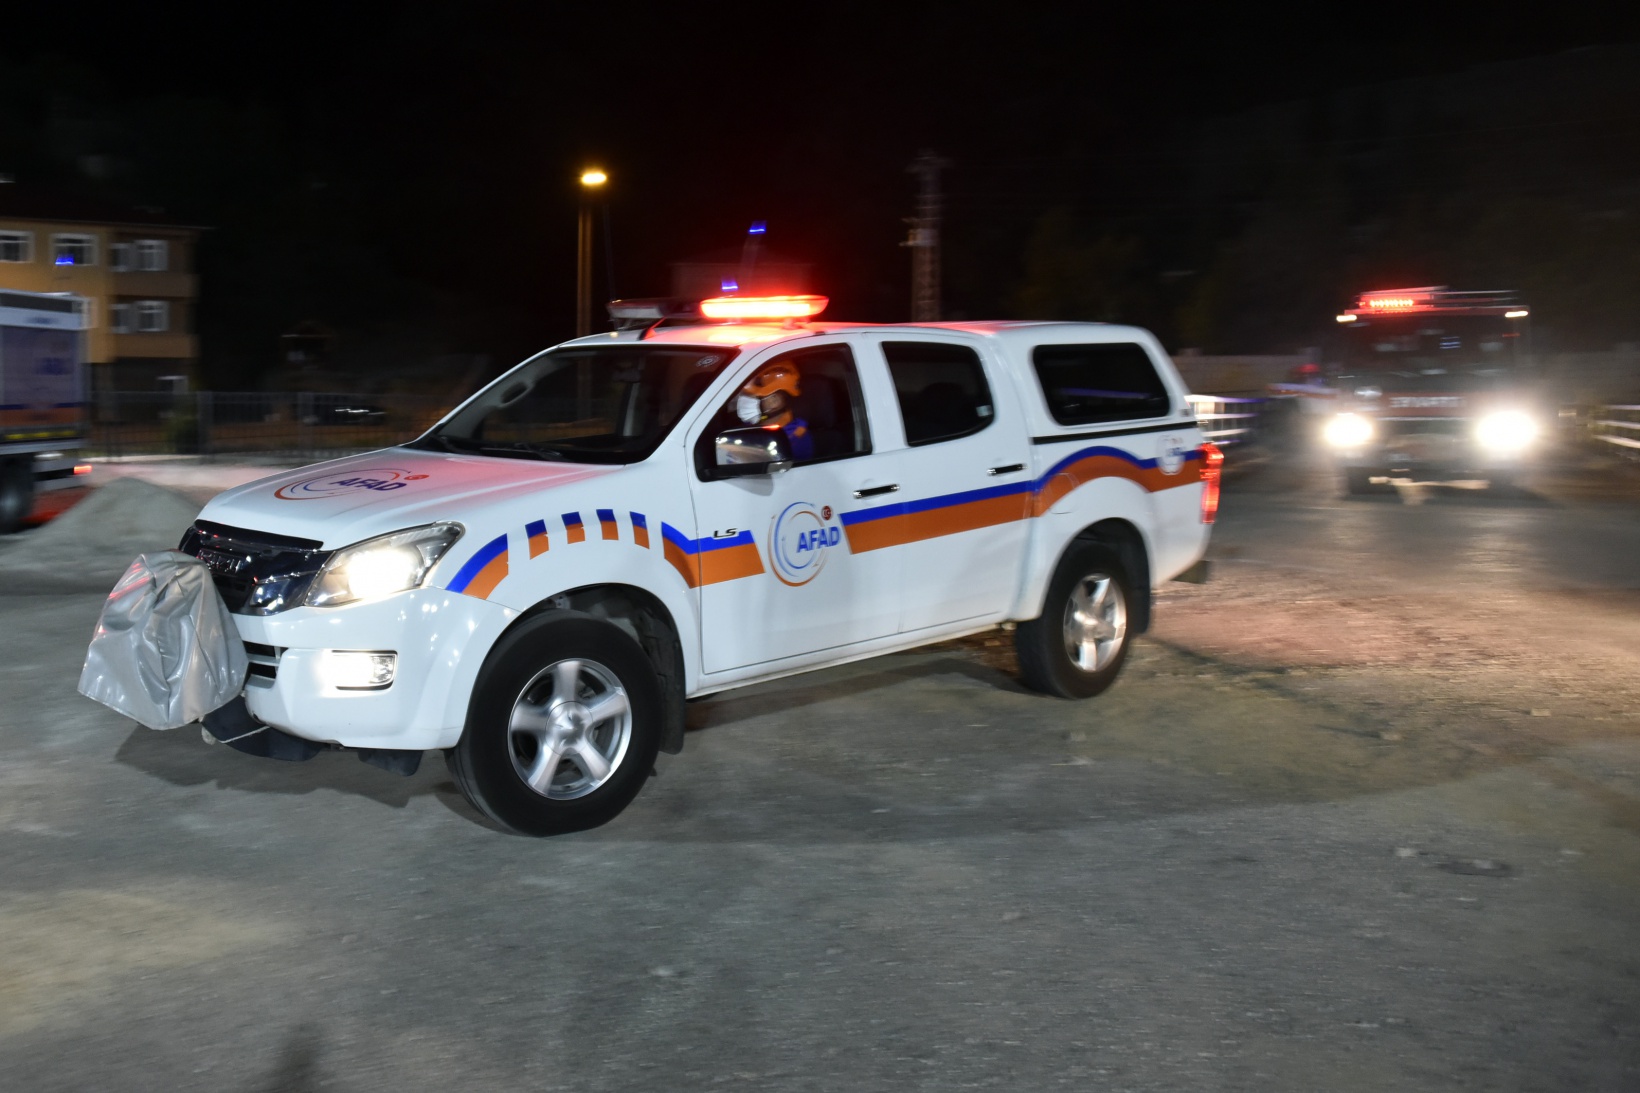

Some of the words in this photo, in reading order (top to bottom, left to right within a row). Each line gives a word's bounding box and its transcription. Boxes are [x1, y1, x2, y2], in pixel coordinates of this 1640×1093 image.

[328, 478, 407, 491] AFAD
[713, 528, 738, 538] LS
[796, 526, 841, 553] AFAD
